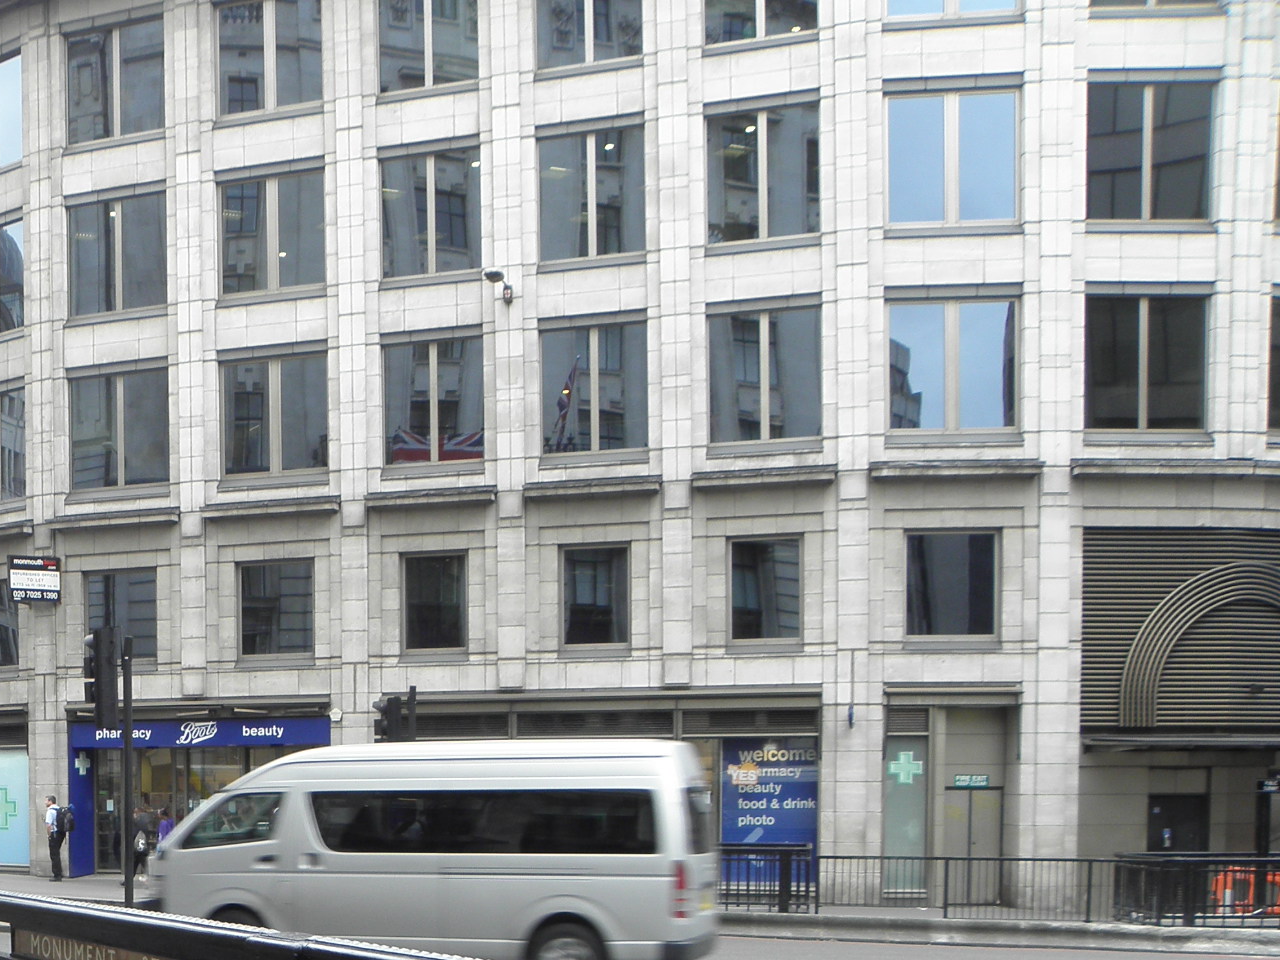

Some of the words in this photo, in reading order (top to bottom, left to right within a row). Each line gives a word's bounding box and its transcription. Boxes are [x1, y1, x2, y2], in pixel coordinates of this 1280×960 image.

[95, 728, 152, 740] pharacy
[176, 721, 218, 744] Boots
[242, 725, 284, 738] beauty
[738, 748, 816, 761] welcome
[731, 770, 758, 781] YES
[738, 783, 782, 794] beauty
[738, 798, 767, 809] food
[770, 798, 780, 809] &
[783, 798, 816, 809] drink
[738, 814, 775, 827] photo
